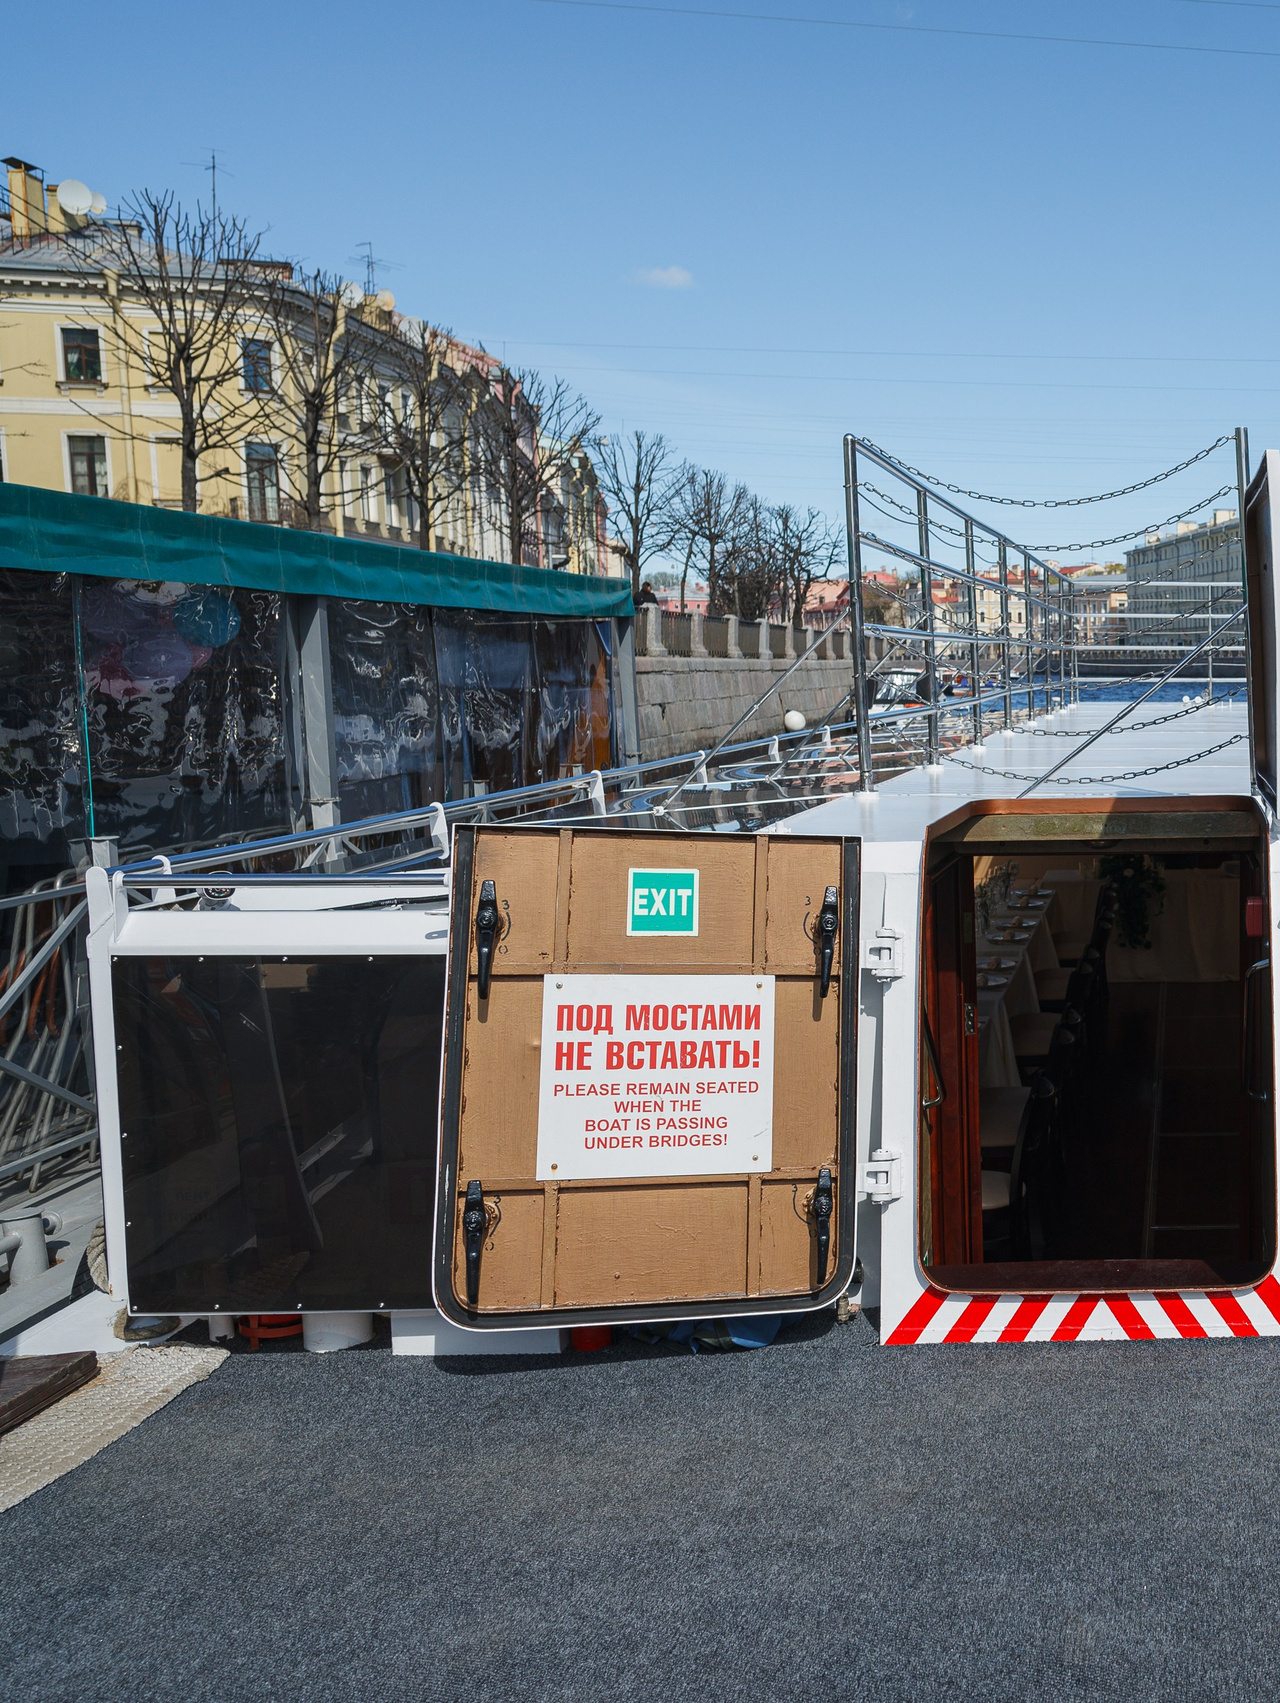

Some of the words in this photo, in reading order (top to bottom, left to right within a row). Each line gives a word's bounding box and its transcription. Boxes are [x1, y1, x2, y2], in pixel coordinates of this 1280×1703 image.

[633, 888, 693, 917] EXIT
[555, 1004, 614, 1036] ПОД
[625, 1004, 761, 1031] МОСТАМИ
[554, 1041, 593, 1071] НЕ
[605, 1040, 761, 1070] ВСТАВАТЬ!
[553, 1082, 621, 1098] PLEASE
[626, 1082, 691, 1096] REMAIN
[695, 1081, 759, 1095] SEATED
[613, 1100, 665, 1114] WHEN
[669, 1100, 702, 1113] THE
[584, 1118, 631, 1133] BOAT
[636, 1118, 651, 1131] IS
[656, 1116, 728, 1131] PASSING
[584, 1135, 643, 1150] UNDER
[648, 1133, 728, 1149] BRIDGES!
